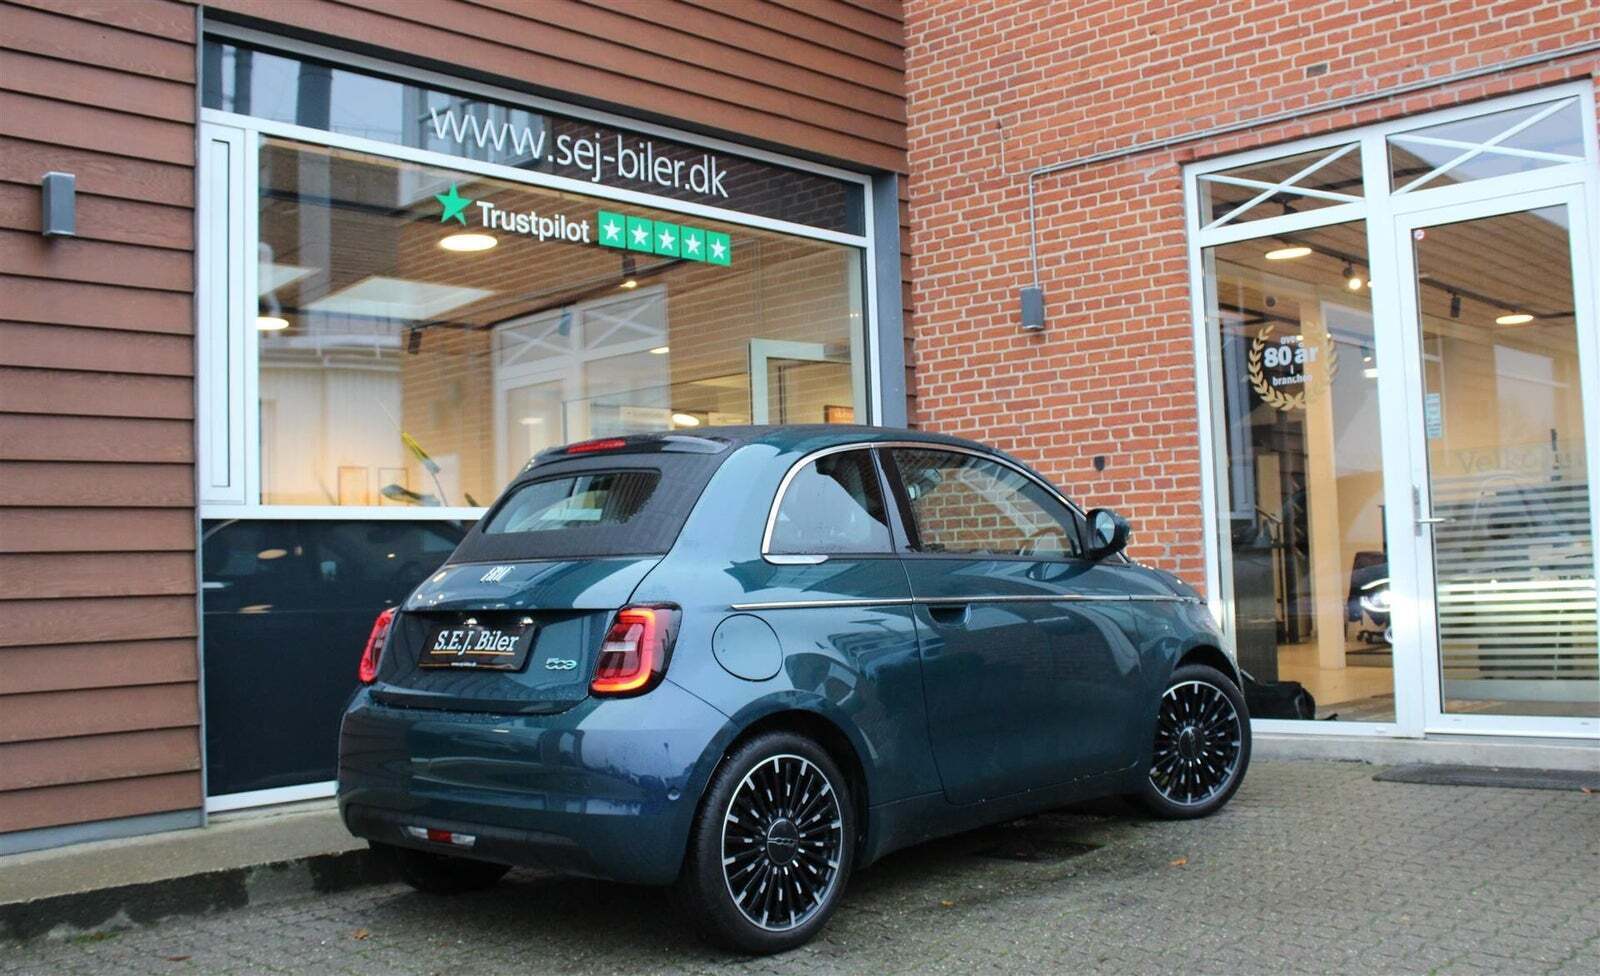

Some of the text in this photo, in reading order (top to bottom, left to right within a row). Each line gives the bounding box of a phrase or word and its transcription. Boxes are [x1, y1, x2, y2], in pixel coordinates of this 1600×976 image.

[430, 106, 728, 198] www.sej-biler.dk
[476, 200, 590, 243] Trustpilot
[1263, 345, 1292, 367] 80
[474, 630, 519, 651] Biler
